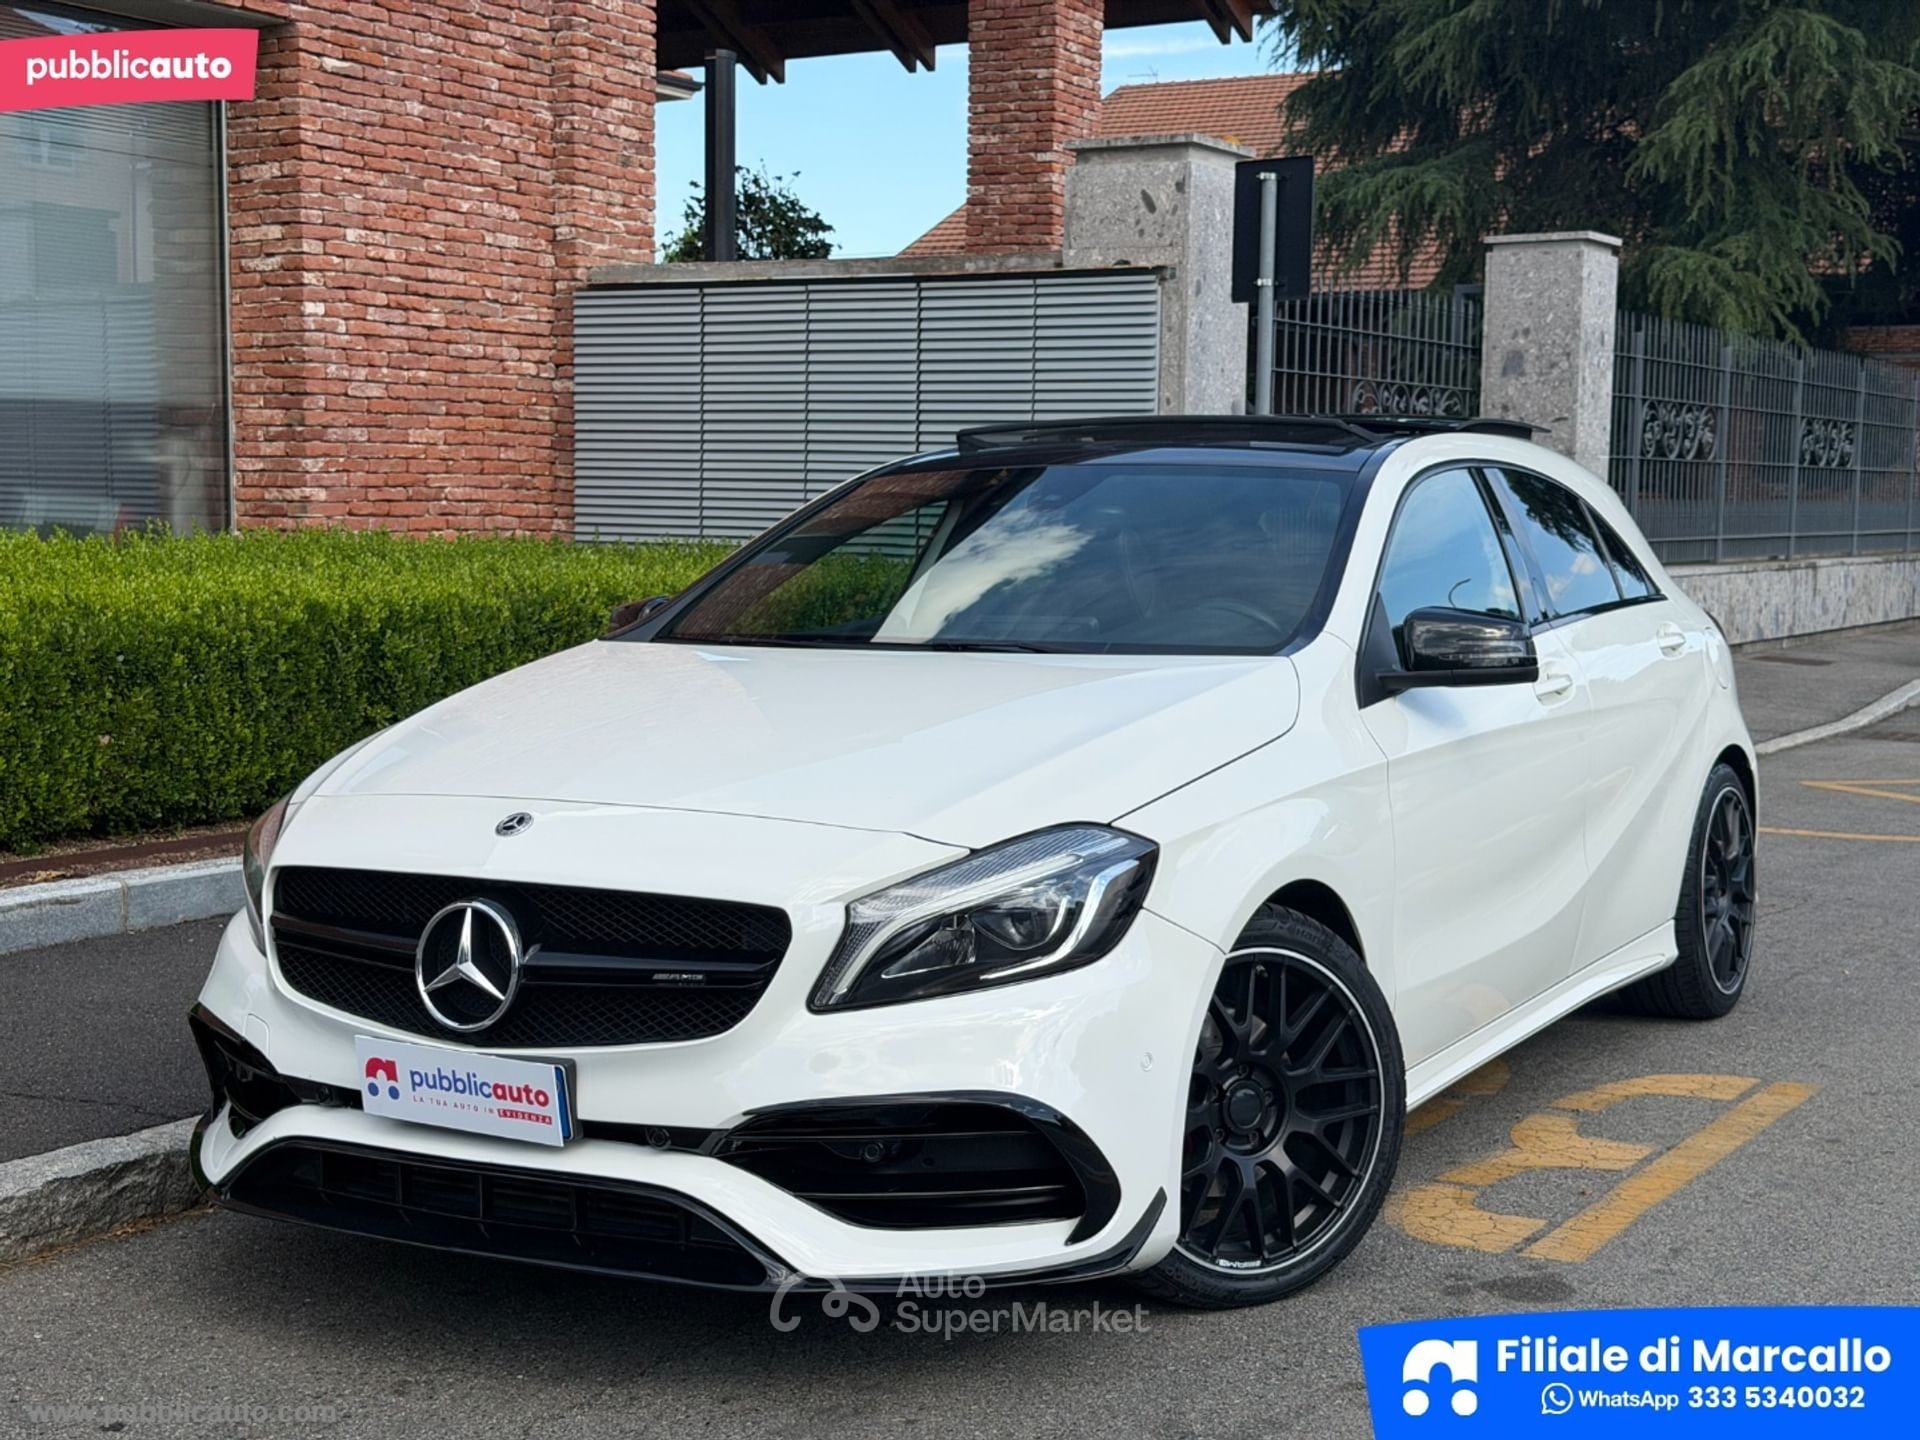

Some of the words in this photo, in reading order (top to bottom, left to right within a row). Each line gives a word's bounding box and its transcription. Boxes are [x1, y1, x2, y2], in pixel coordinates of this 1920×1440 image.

[409, 1067, 550, 1108] pubblicauto
[412, 1095, 425, 1103] LA
[453, 1101, 479, 1112] AUTO
[498, 1109, 552, 1124] EVIDENZA
